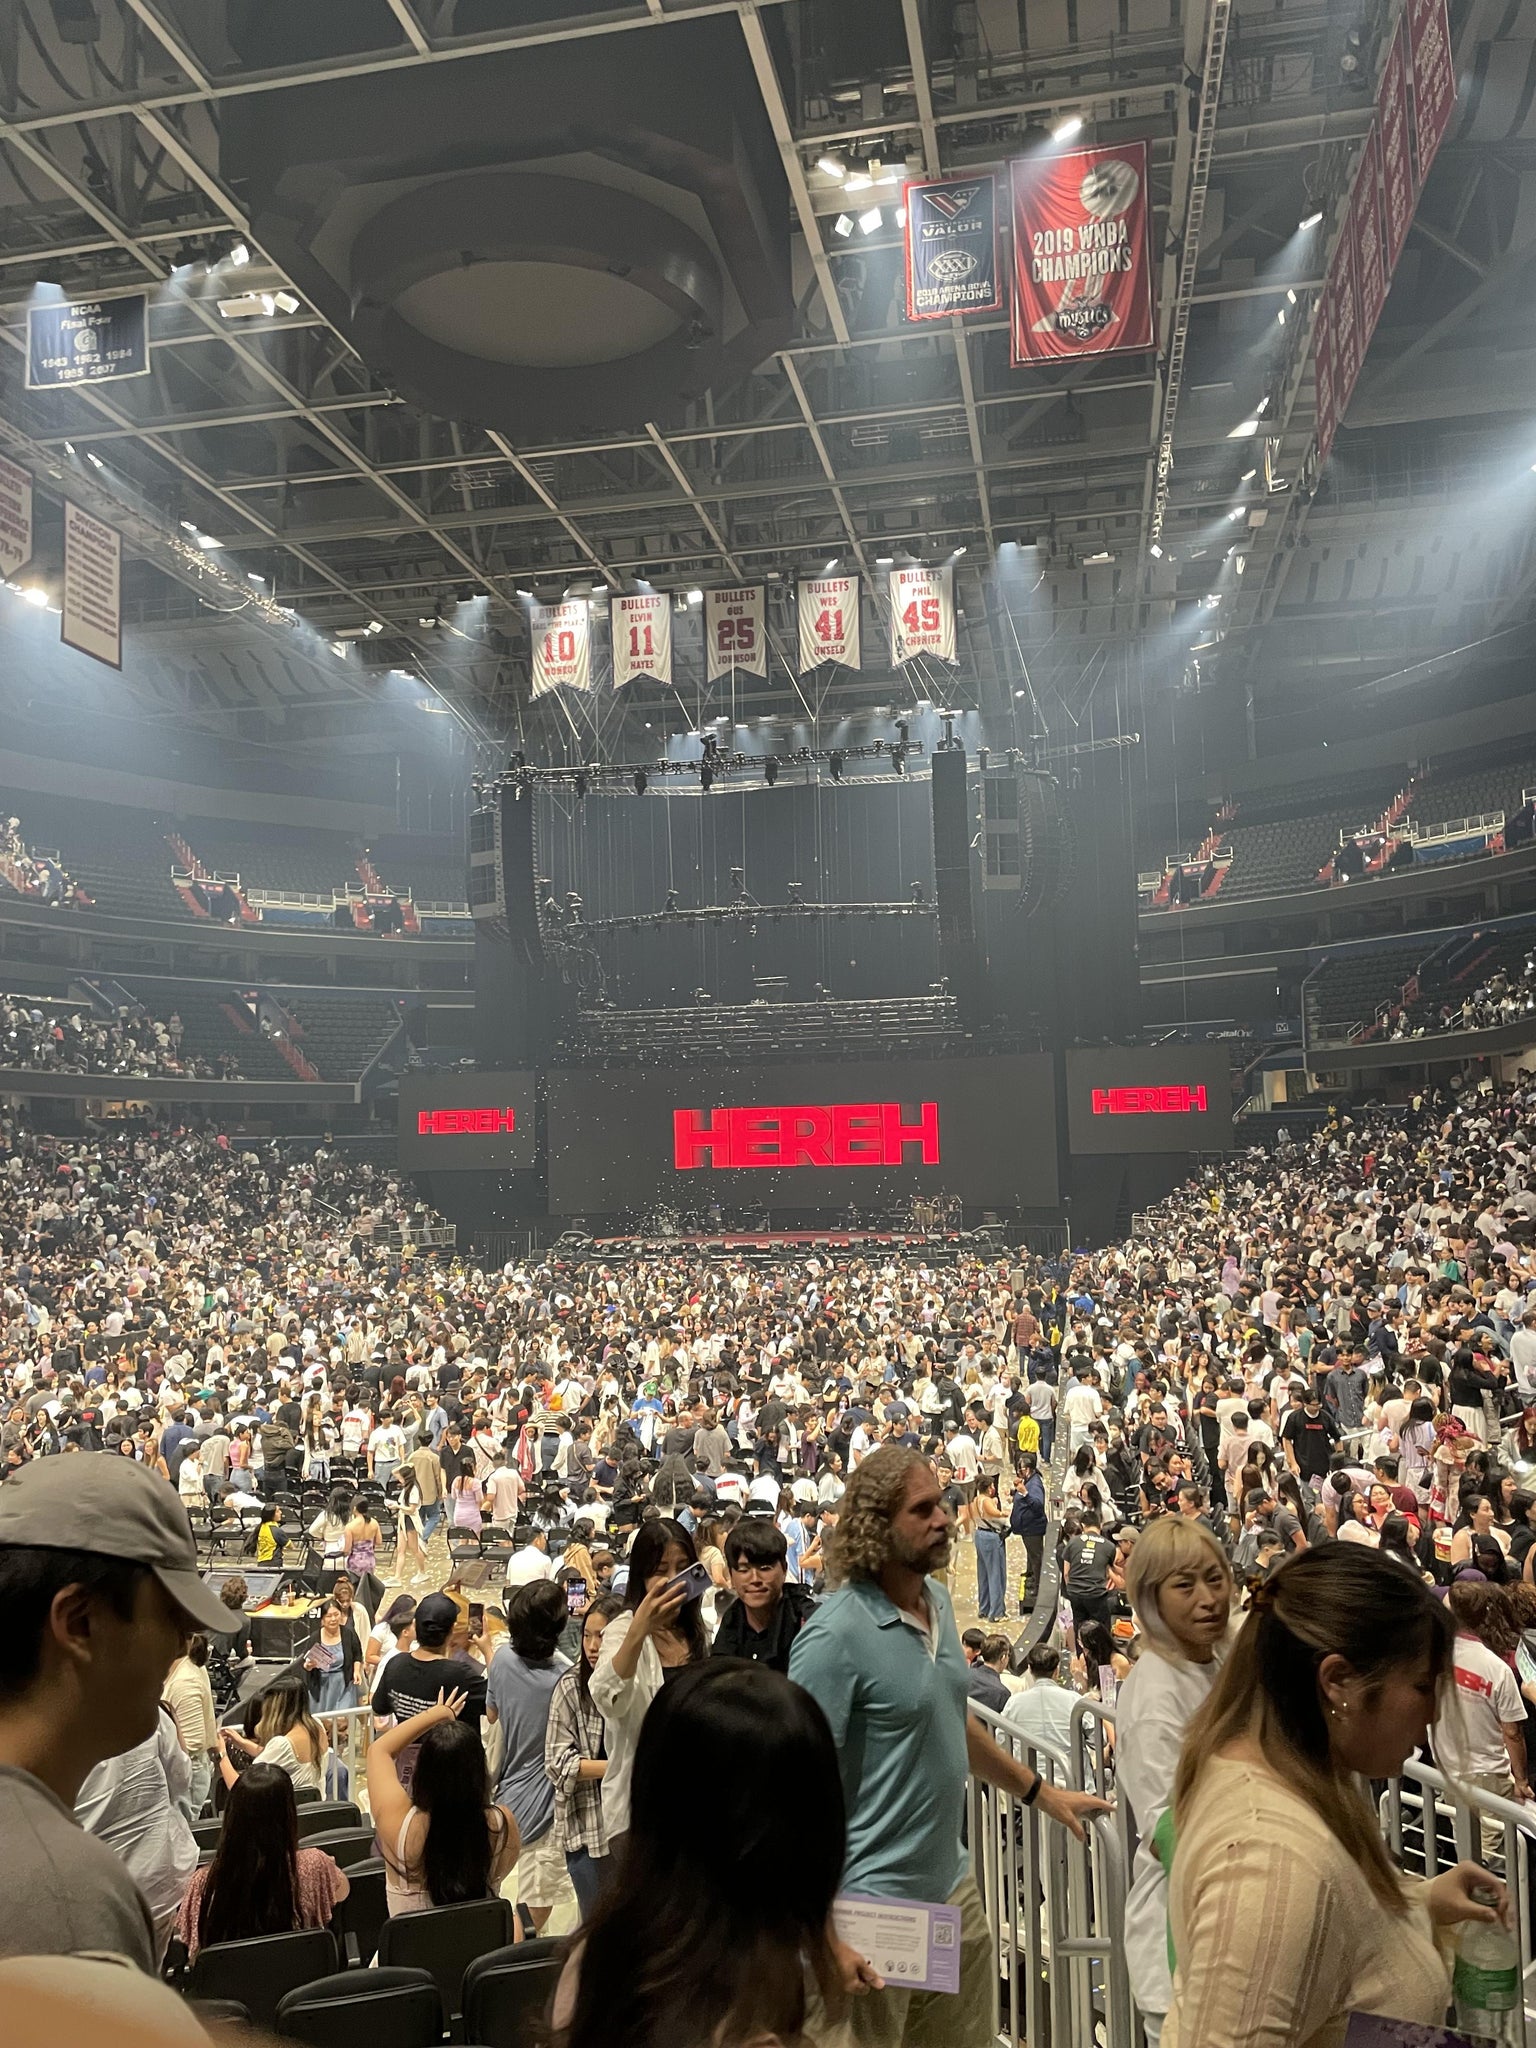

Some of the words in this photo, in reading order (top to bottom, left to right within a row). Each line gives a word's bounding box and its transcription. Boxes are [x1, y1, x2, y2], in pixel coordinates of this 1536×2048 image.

[922, 221, 983, 237] VALOR
[1033, 227, 1074, 256] 2019
[1077, 219, 1129, 253] WNBA
[1032, 247, 1133, 284] CHAMPIONS
[939, 284, 967, 295] ARENA
[967, 280, 991, 290] BOWL
[916, 288, 992, 307] CHAMPIONS
[71, 304, 102, 316] NCAA
[61, 319, 87, 330] Final
[88, 316, 112, 326] Four
[69, 520, 117, 556] CHAMPIONS
[900, 570, 943, 584] BULLETS
[807, 580, 850, 594] BULLETS
[912, 586, 931, 596] PHIL
[621, 597, 661, 610] BULLETS
[715, 589, 756, 604] BULLETS
[820, 596, 837, 607] WES
[539, 605, 578, 619] BULLETS
[630, 612, 652, 623] ELVIN
[727, 606, 744, 616] GUS
[902, 598, 940, 633] 45
[814, 609, 845, 642] 41
[629, 625, 654, 657] 11
[717, 617, 754, 651] 25
[905, 635, 942, 647] CHENIER
[544, 631, 575, 663] 10
[814, 645, 845, 656] UNSELD
[630, 660, 654, 670] HAYES
[718, 652, 756, 664] JOHNSON
[544, 664, 578, 676] MONROE
[1091, 1085, 1208, 1114] HEREH
[417, 1108, 515, 1135] HEREH
[672, 1102, 940, 1170] HEREH
